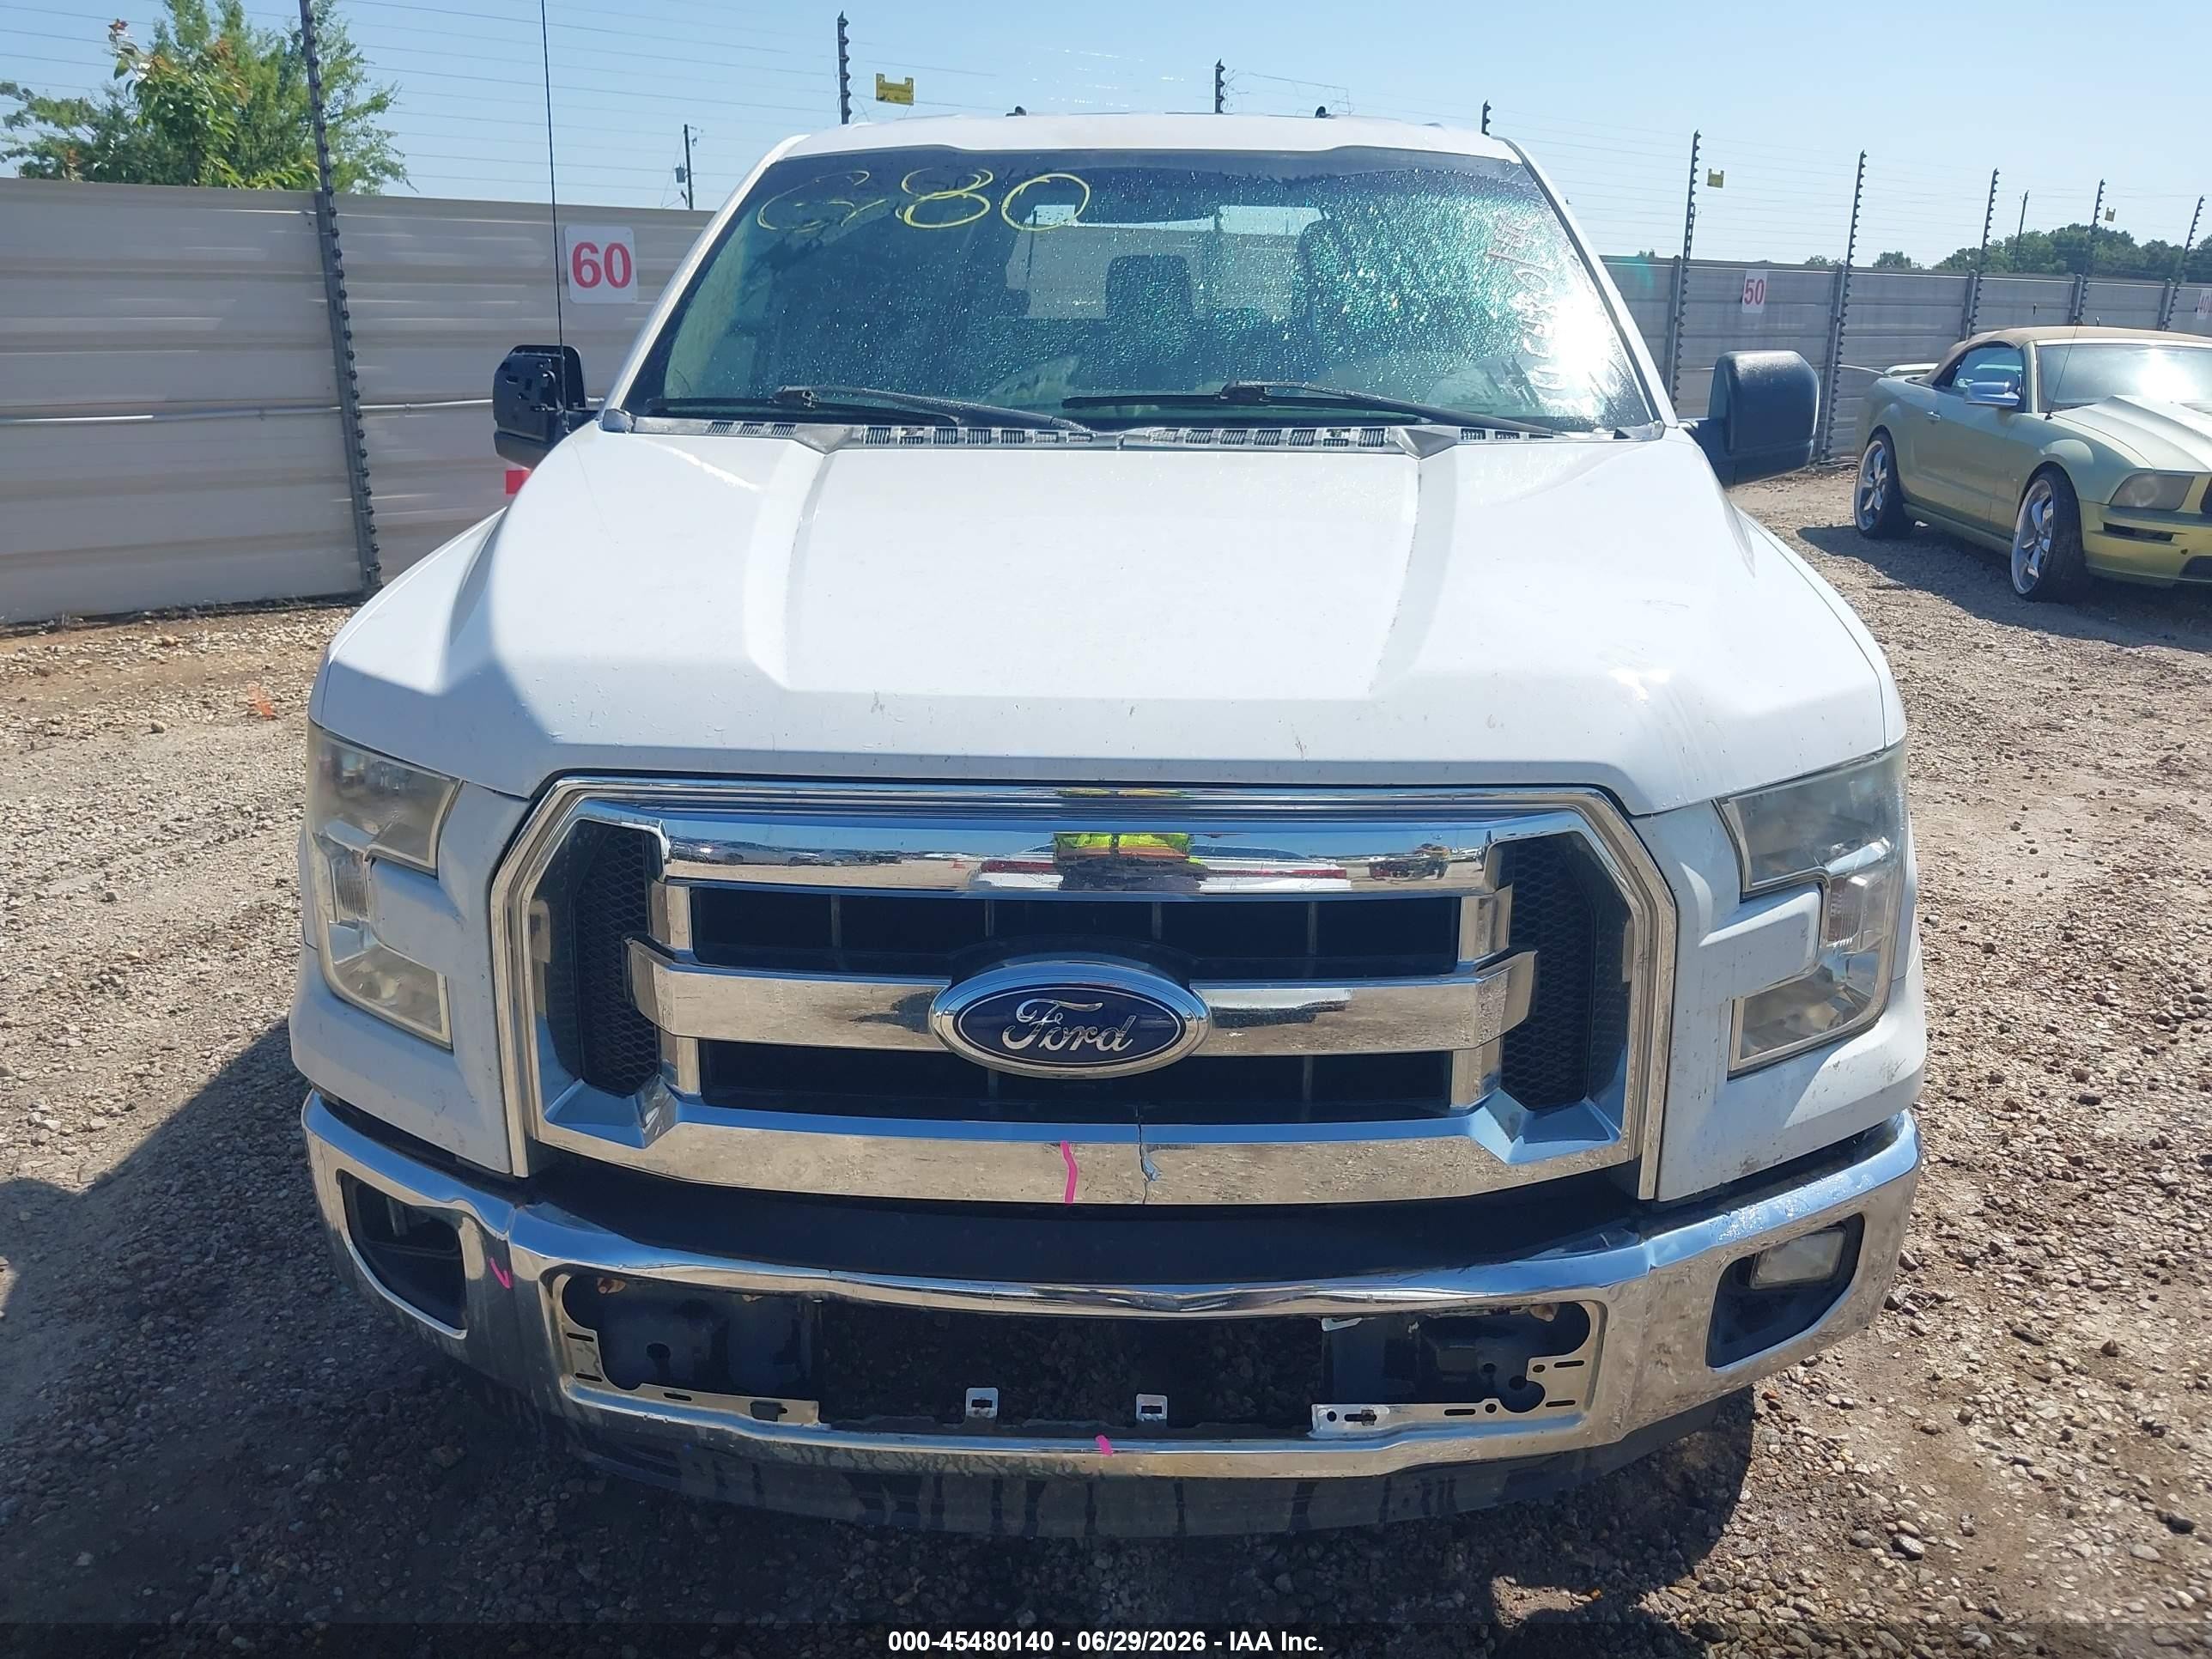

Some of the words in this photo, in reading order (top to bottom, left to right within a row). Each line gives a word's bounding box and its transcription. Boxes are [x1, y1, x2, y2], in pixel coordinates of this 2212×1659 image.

[572, 241, 632, 289] 60
[1744, 278, 1765, 306] 50
[1002, 998, 1136, 1052] Ford
